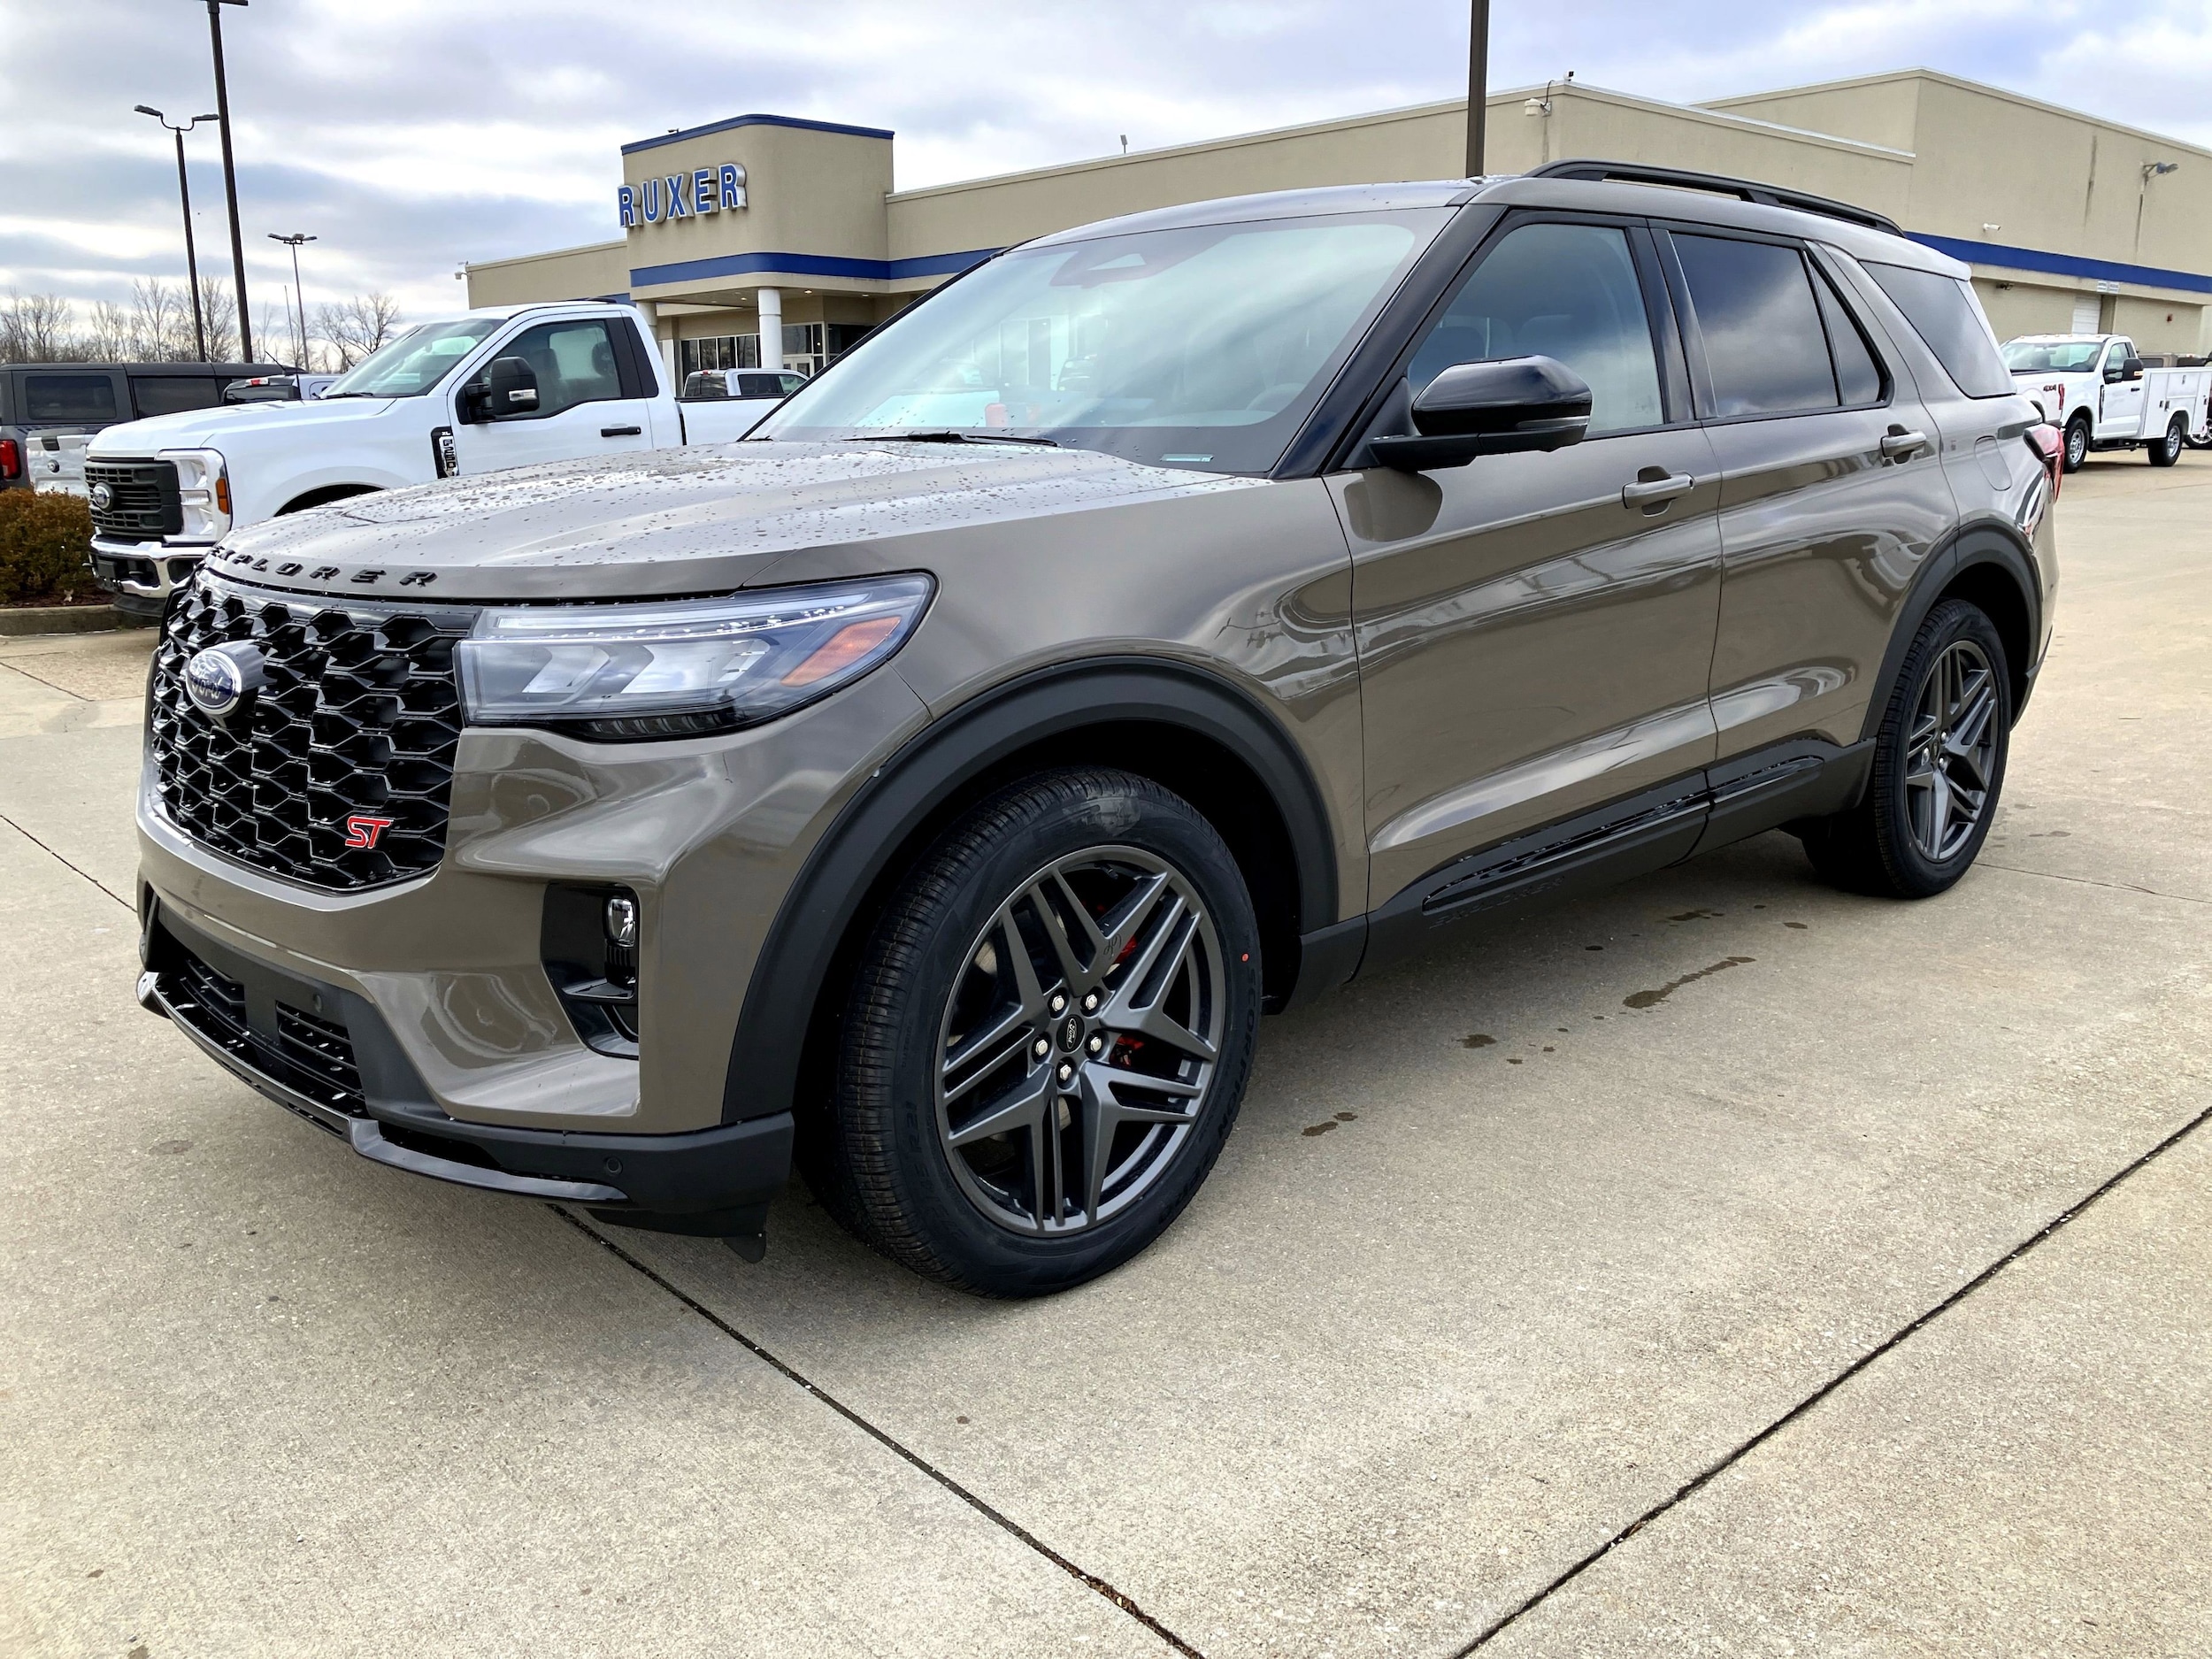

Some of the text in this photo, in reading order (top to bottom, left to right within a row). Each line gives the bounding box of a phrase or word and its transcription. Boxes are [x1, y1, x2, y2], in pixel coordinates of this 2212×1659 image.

[618, 163, 747, 227] RUXER
[344, 815, 394, 849] ST
[1214, 966, 1256, 1140] SCORPION
